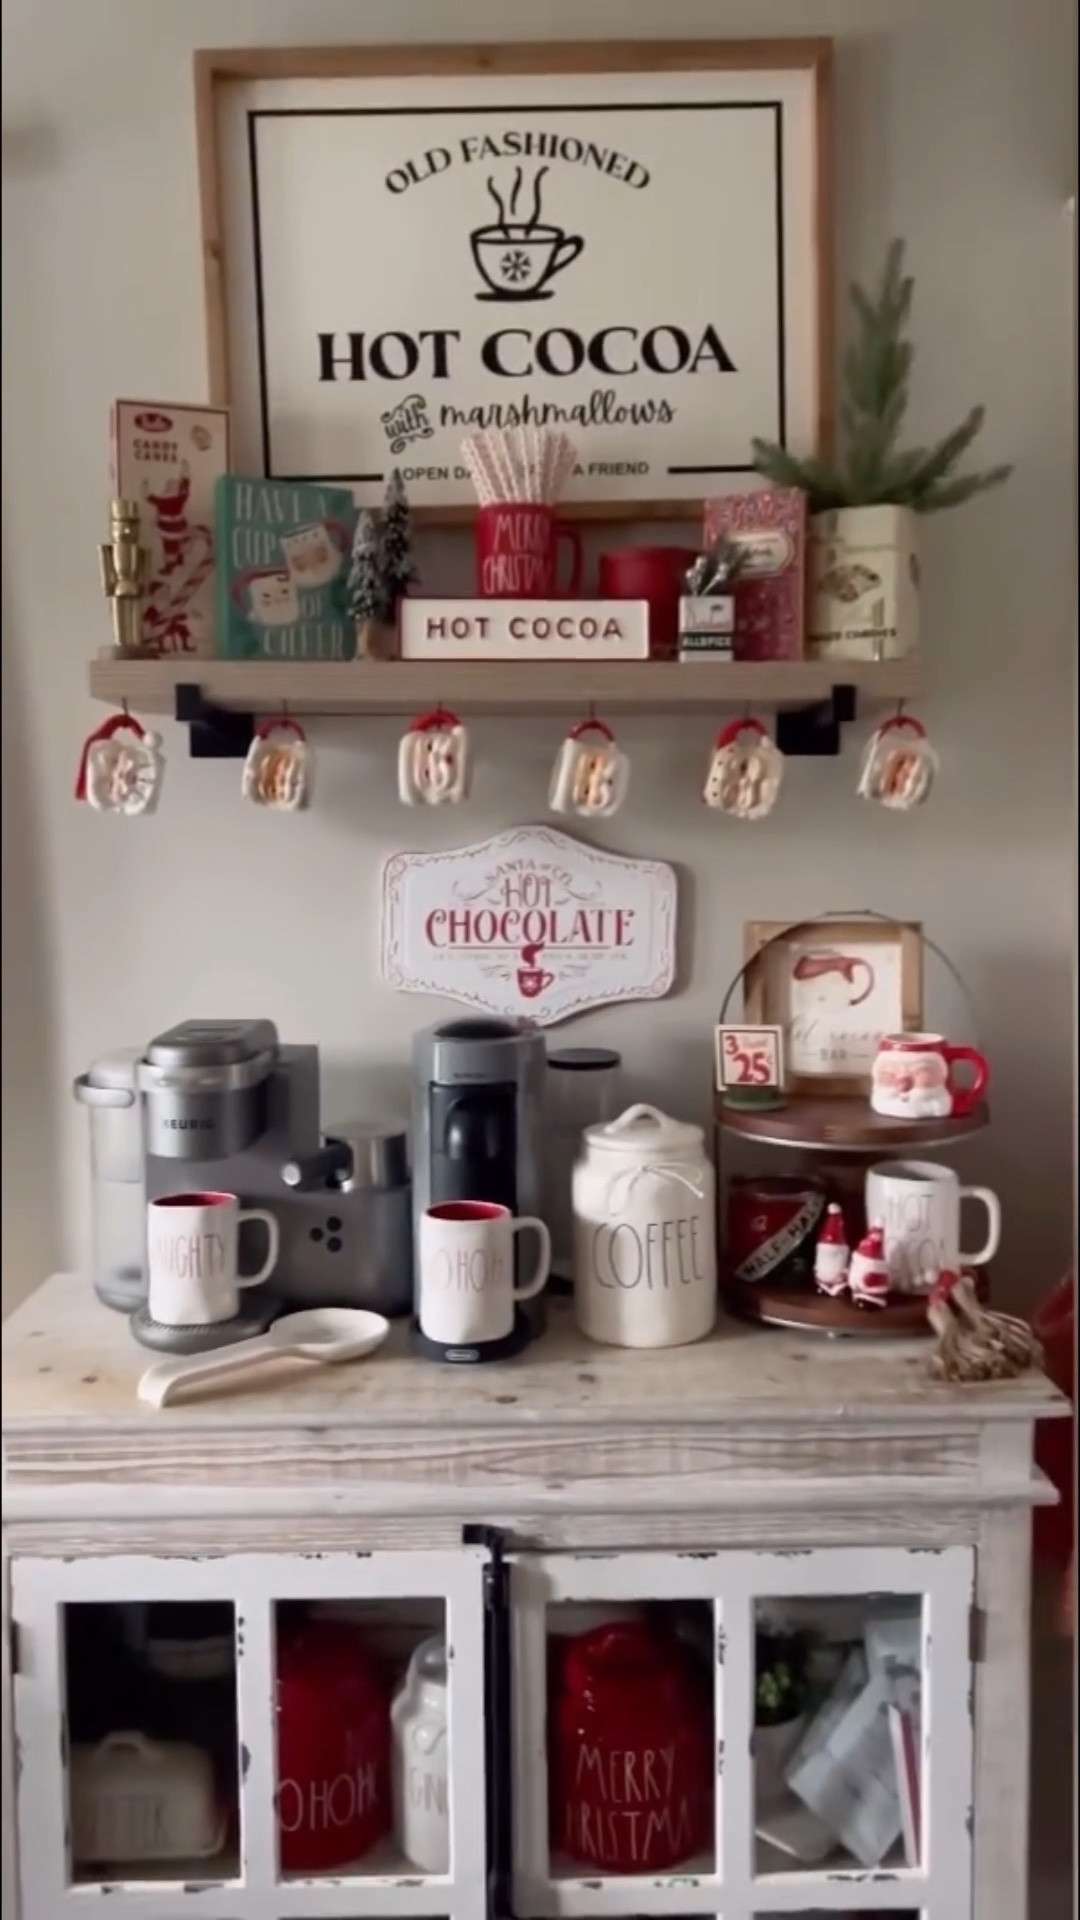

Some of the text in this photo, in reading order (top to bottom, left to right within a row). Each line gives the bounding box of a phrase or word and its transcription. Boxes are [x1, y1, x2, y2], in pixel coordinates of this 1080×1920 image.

[385, 131, 650, 194] OLD FASHIONED
[317, 323, 739, 381] HOT COCOA
[381, 391, 676, 450] with marshmallows
[403, 466, 448, 481] OPEN
[588, 461, 649, 476] FRIEND
[427, 617, 623, 640] HOT COCOA
[500, 873, 552, 908] HOT
[425, 908, 635, 948] CHOCOLATE
[725, 1035, 739, 1055] 3
[592, 1216, 703, 1291] COFFEE
[577, 1743, 675, 1803] MERRY
